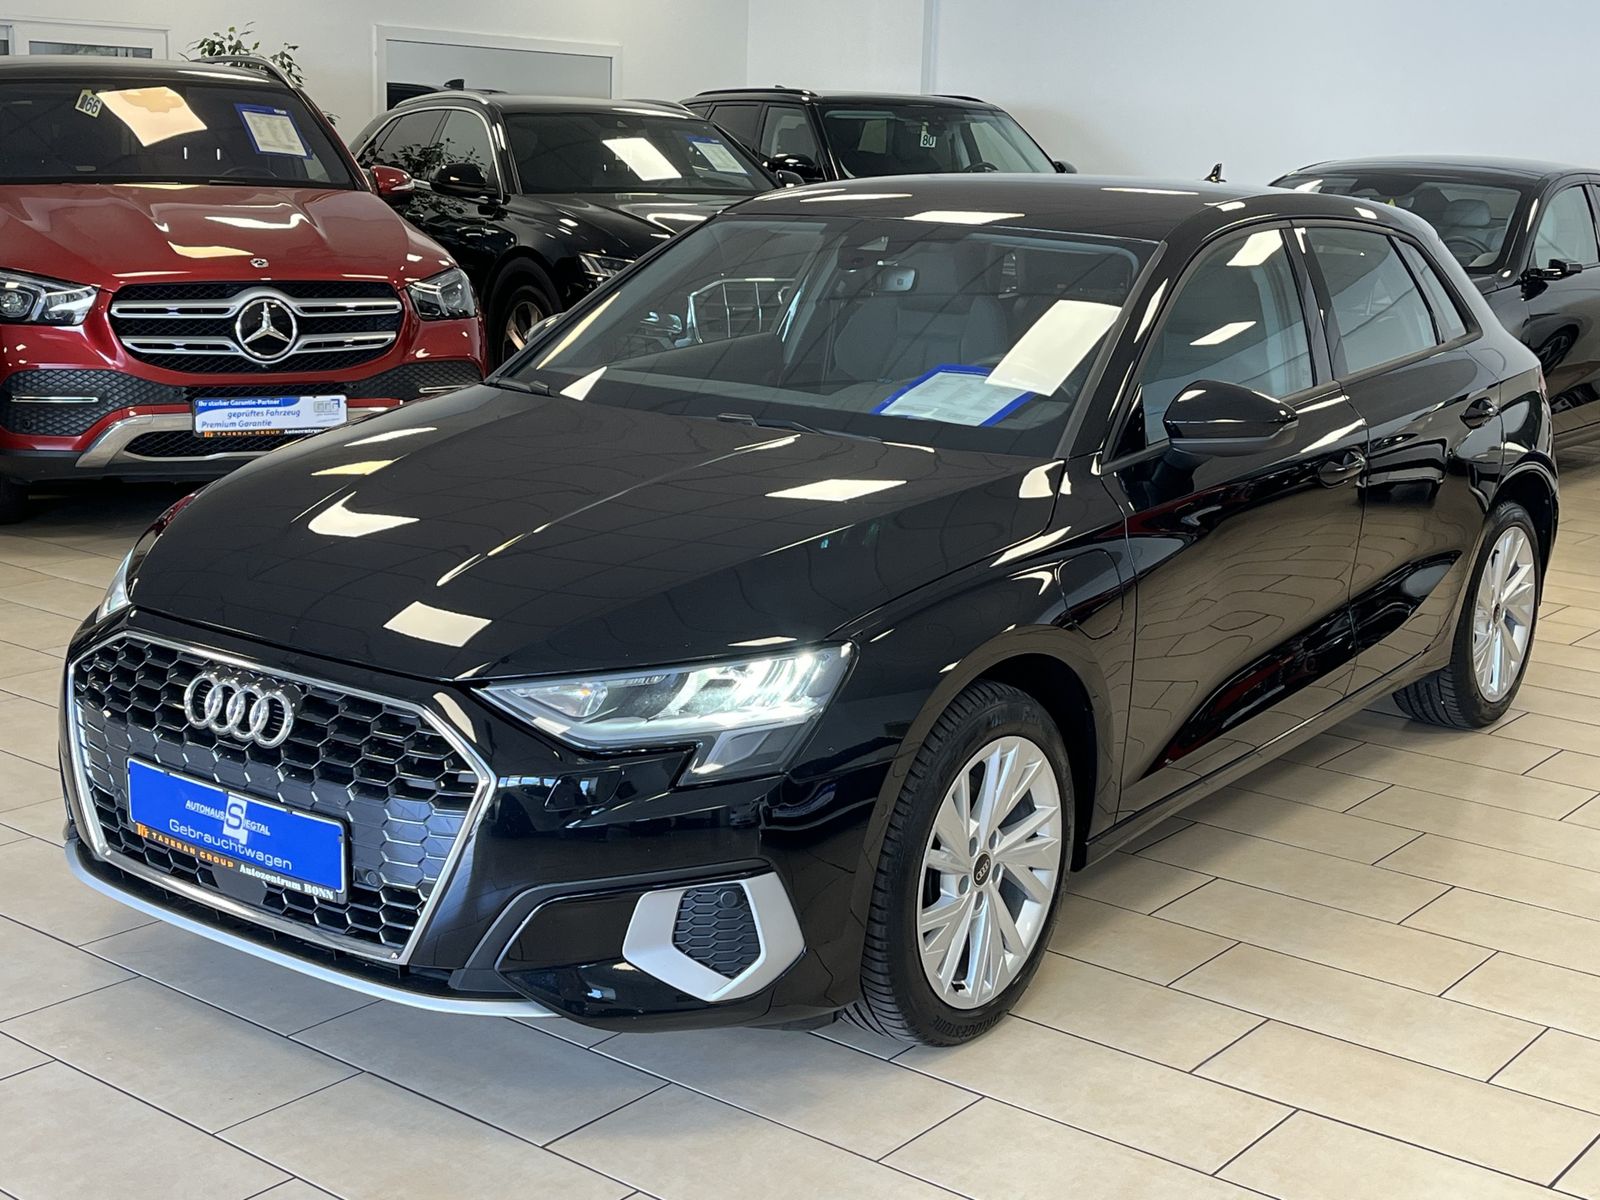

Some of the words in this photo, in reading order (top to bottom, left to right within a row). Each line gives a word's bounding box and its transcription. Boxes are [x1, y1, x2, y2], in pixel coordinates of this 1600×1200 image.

[922, 134, 935, 146] 80
[227, 409, 265, 420] geprüftes
[265, 409, 301, 418] Fahrzeug
[201, 420, 237, 429] Premium
[238, 420, 272, 429] Garantie
[185, 800, 226, 820] AUTOHAUS
[169, 818, 293, 871] Gebrauchtwagen
[199, 850, 234, 868] GROUP
[239, 863, 302, 891] Autozentrum
[303, 883, 334, 900] BONN
